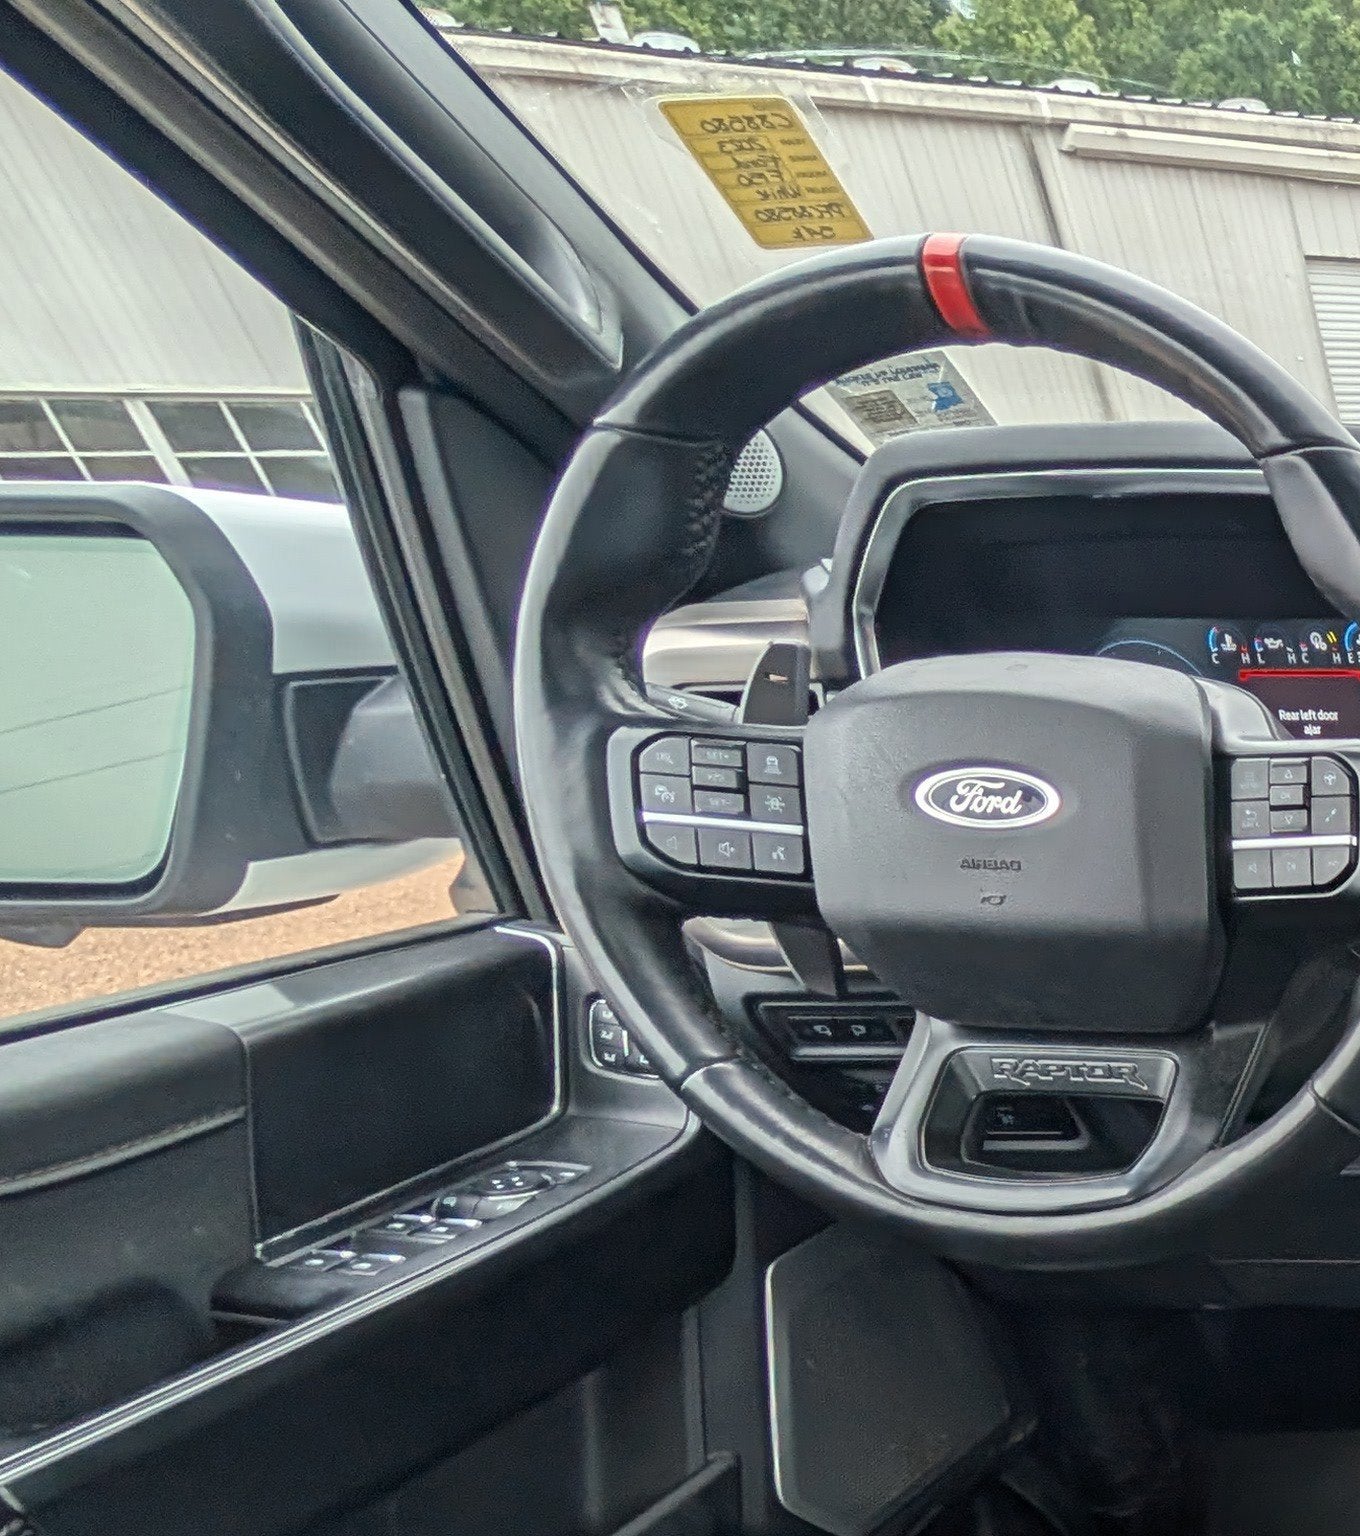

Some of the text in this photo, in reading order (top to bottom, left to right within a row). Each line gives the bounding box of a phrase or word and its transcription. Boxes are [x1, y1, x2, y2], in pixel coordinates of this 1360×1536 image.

[1278, 708, 1339, 721] Rear left door
[949, 779, 1023, 815] Ford
[990, 1058, 1149, 1090] RAPTOR
